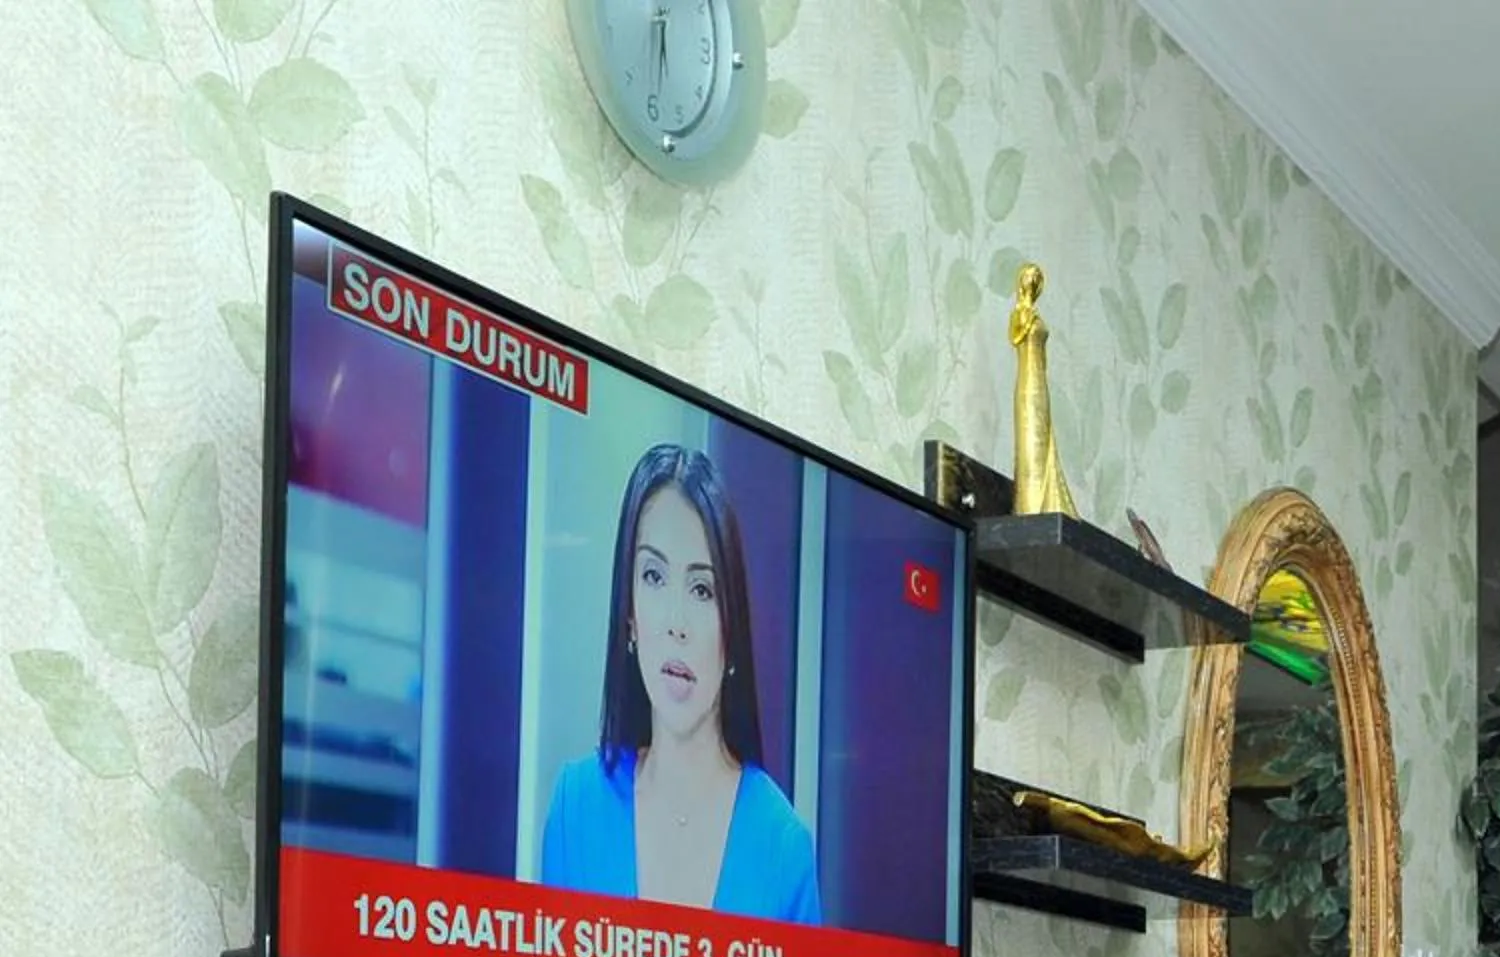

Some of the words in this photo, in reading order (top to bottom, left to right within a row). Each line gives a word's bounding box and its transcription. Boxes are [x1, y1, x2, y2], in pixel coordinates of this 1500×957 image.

[343, 261, 431, 339] SON
[445, 307, 576, 401] DURUM
[353, 893, 417, 942] 120
[425, 900, 567, 957] SAATLİK
